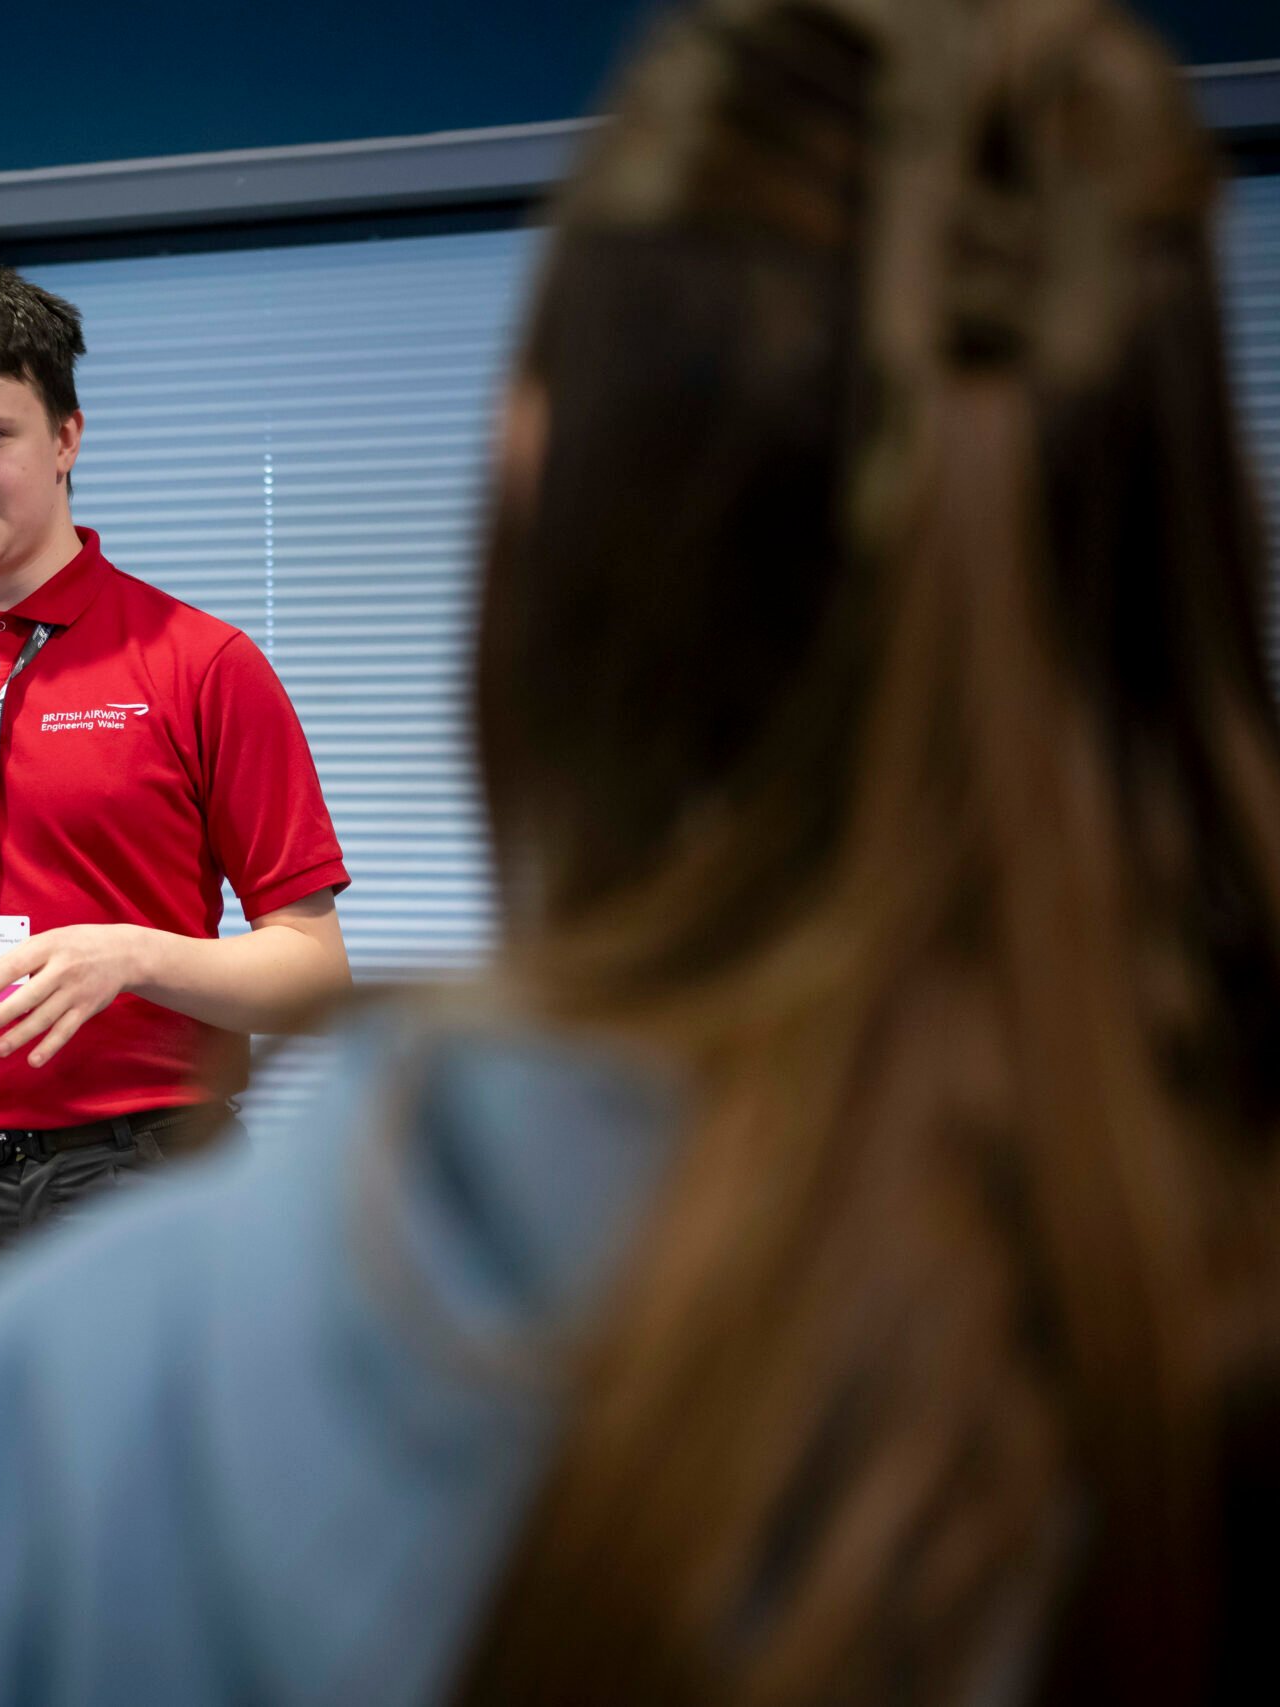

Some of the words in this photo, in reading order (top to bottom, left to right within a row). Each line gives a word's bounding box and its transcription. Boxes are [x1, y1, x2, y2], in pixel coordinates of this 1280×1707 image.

[42, 711, 82, 723] BRITISH
[83, 709, 127, 721] AIRWAYS
[41, 720, 94, 732] Engineering
[97, 720, 125, 729] Wales
